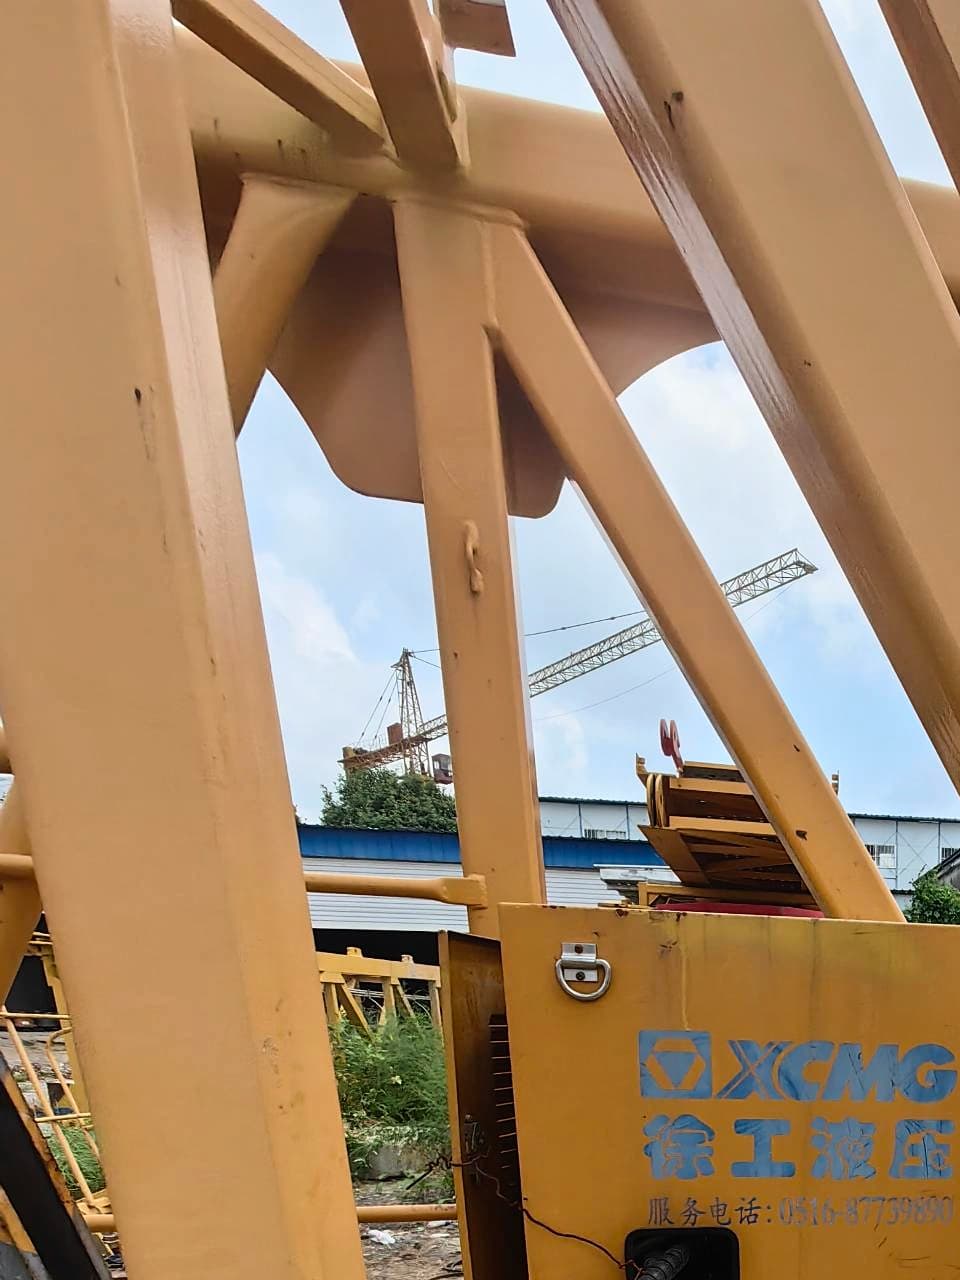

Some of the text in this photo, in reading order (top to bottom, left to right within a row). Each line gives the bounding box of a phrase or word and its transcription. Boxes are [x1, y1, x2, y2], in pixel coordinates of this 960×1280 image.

[717, 1040, 958, 1103] XCMG
[643, 1114, 955, 1179] 徐工液压
